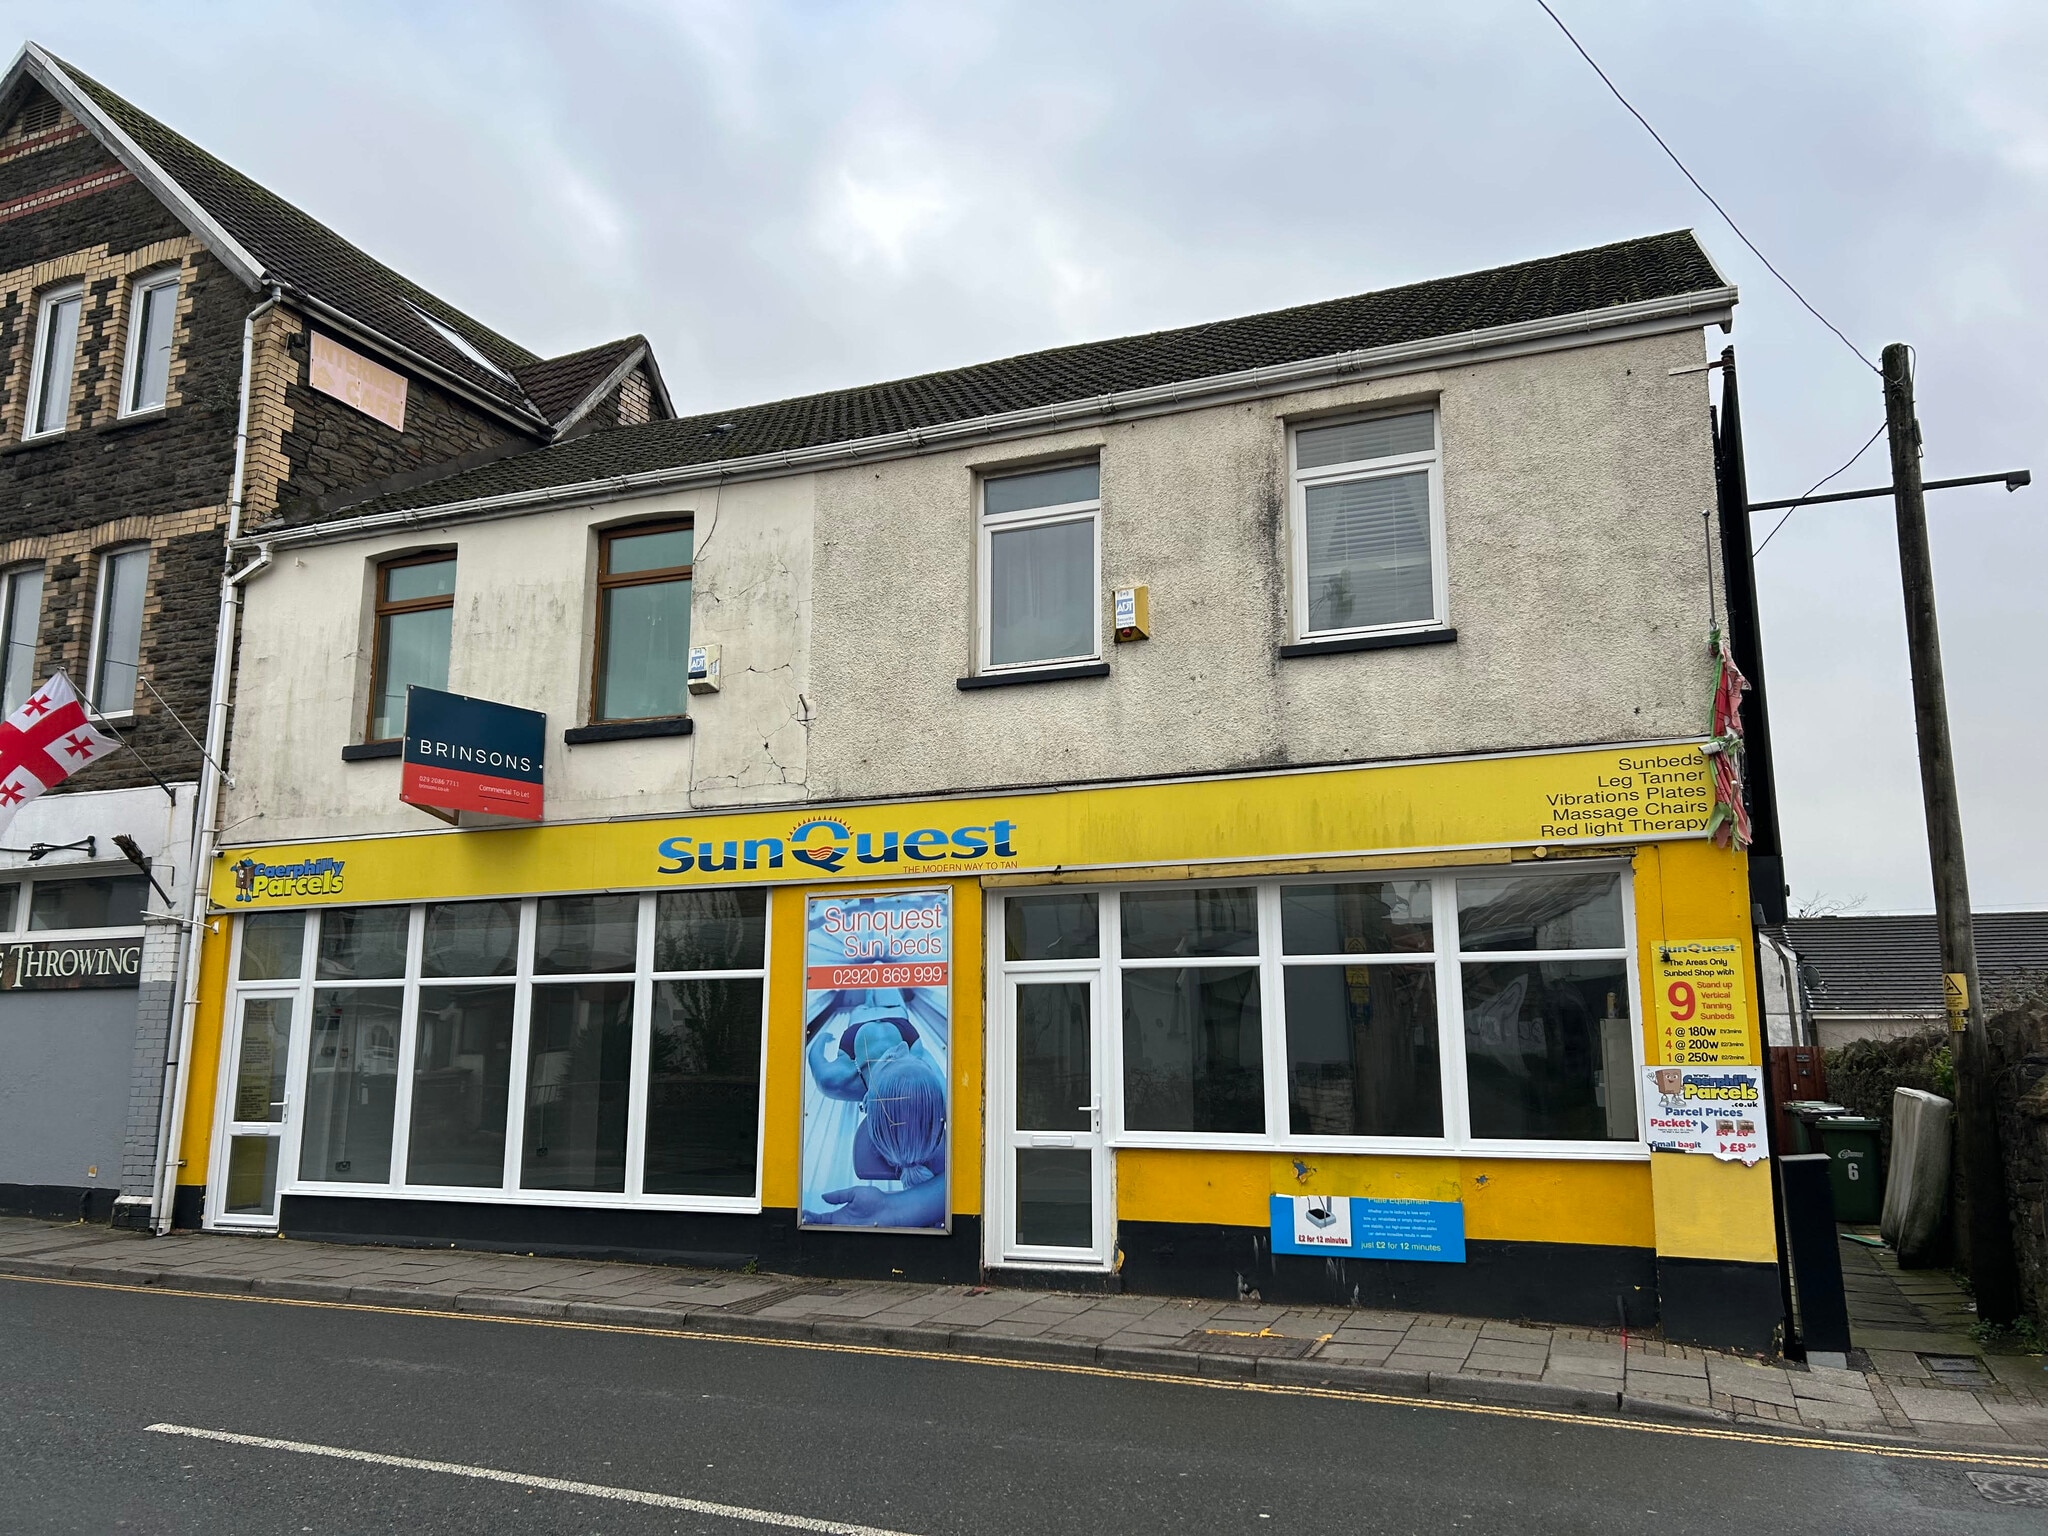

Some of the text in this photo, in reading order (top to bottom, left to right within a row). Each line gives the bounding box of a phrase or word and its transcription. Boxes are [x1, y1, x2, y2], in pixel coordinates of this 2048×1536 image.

[314, 334, 404, 397] INTERNET
[346, 382, 400, 424] CAFE
[1117, 601, 1133, 612] ADT
[691, 658, 704, 668] ADT
[420, 740, 530, 772] BRINSONS
[1618, 753, 1704, 770] Sunbeds
[1598, 771, 1705, 788] Leg Tanner
[479, 784, 512, 795] Commercial
[1546, 786, 1706, 806] Vibrations Plates
[1553, 802, 1708, 821] Massage Chairs
[1542, 818, 1709, 837] Red light Therapy
[657, 818, 1017, 875] SunQuest
[254, 858, 345, 878] Caerphilly
[922, 864, 962, 872] MODERN
[964, 863, 983, 871] WAY
[252, 870, 344, 898] Parcels
[824, 904, 942, 938] Sunquest
[844, 934, 942, 958] Sun beds
[1659, 943, 1736, 954] SunQuest
[10, 944, 140, 988] THROWING
[1694, 969, 1714, 977] Shop
[833, 966, 942, 985] 02920 869 999
[1668, 981, 1695, 1021] 9
[1665, 1027, 1672, 1036] 4
[1675, 1028, 1685, 1037] @
[1688, 1027, 1716, 1036] 180w
[1665, 1040, 1672, 1049] 4
[1676, 1040, 1685, 1050] @
[1688, 1040, 1719, 1049] 200w
[1667, 1053, 1672, 1062] 1
[1675, 1053, 1685, 1063] @
[1688, 1052, 1718, 1062] 250w
[1683, 1074, 1756, 1088] Caerphilly
[1684, 1082, 1758, 1100] Parcels
[1666, 1108, 1743, 1117] Parcel Prices
[1650, 1118, 1698, 1127] Packet+
[1729, 1143, 1756, 1152] £8.99
[1848, 1163, 1858, 1180] 6
[1361, 1242, 1374, 1250] just
[1412, 1243, 1441, 1251] minutes
